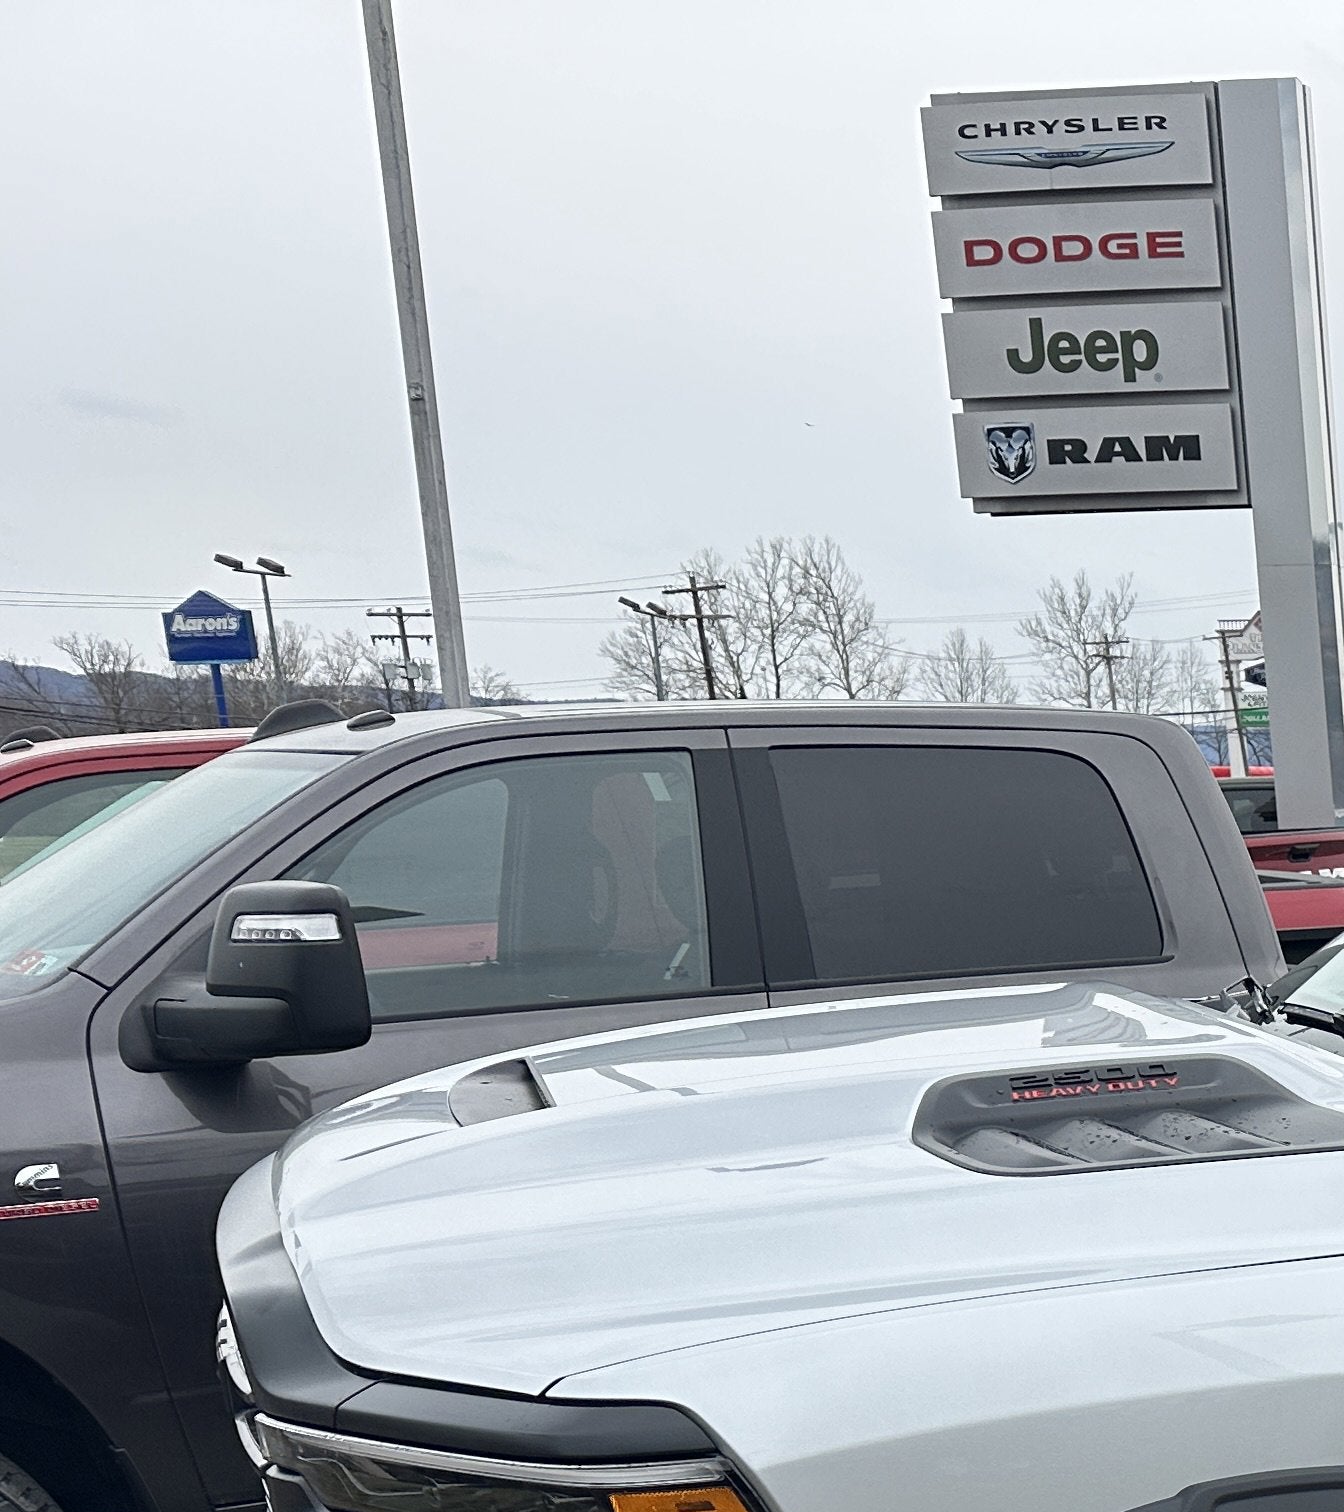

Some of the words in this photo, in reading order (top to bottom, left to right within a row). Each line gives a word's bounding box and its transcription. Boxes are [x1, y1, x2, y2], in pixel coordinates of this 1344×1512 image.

[957, 115, 1168, 140] CHRYSLER
[963, 231, 1185, 267] DODGE
[1006, 317, 1160, 382] Jeep
[1046, 434, 1202, 465] RAM
[171, 613, 239, 632] Aaron's
[1011, 1083, 1101, 1101] HEAVY
[1107, 1077, 1180, 1094] DUTY
